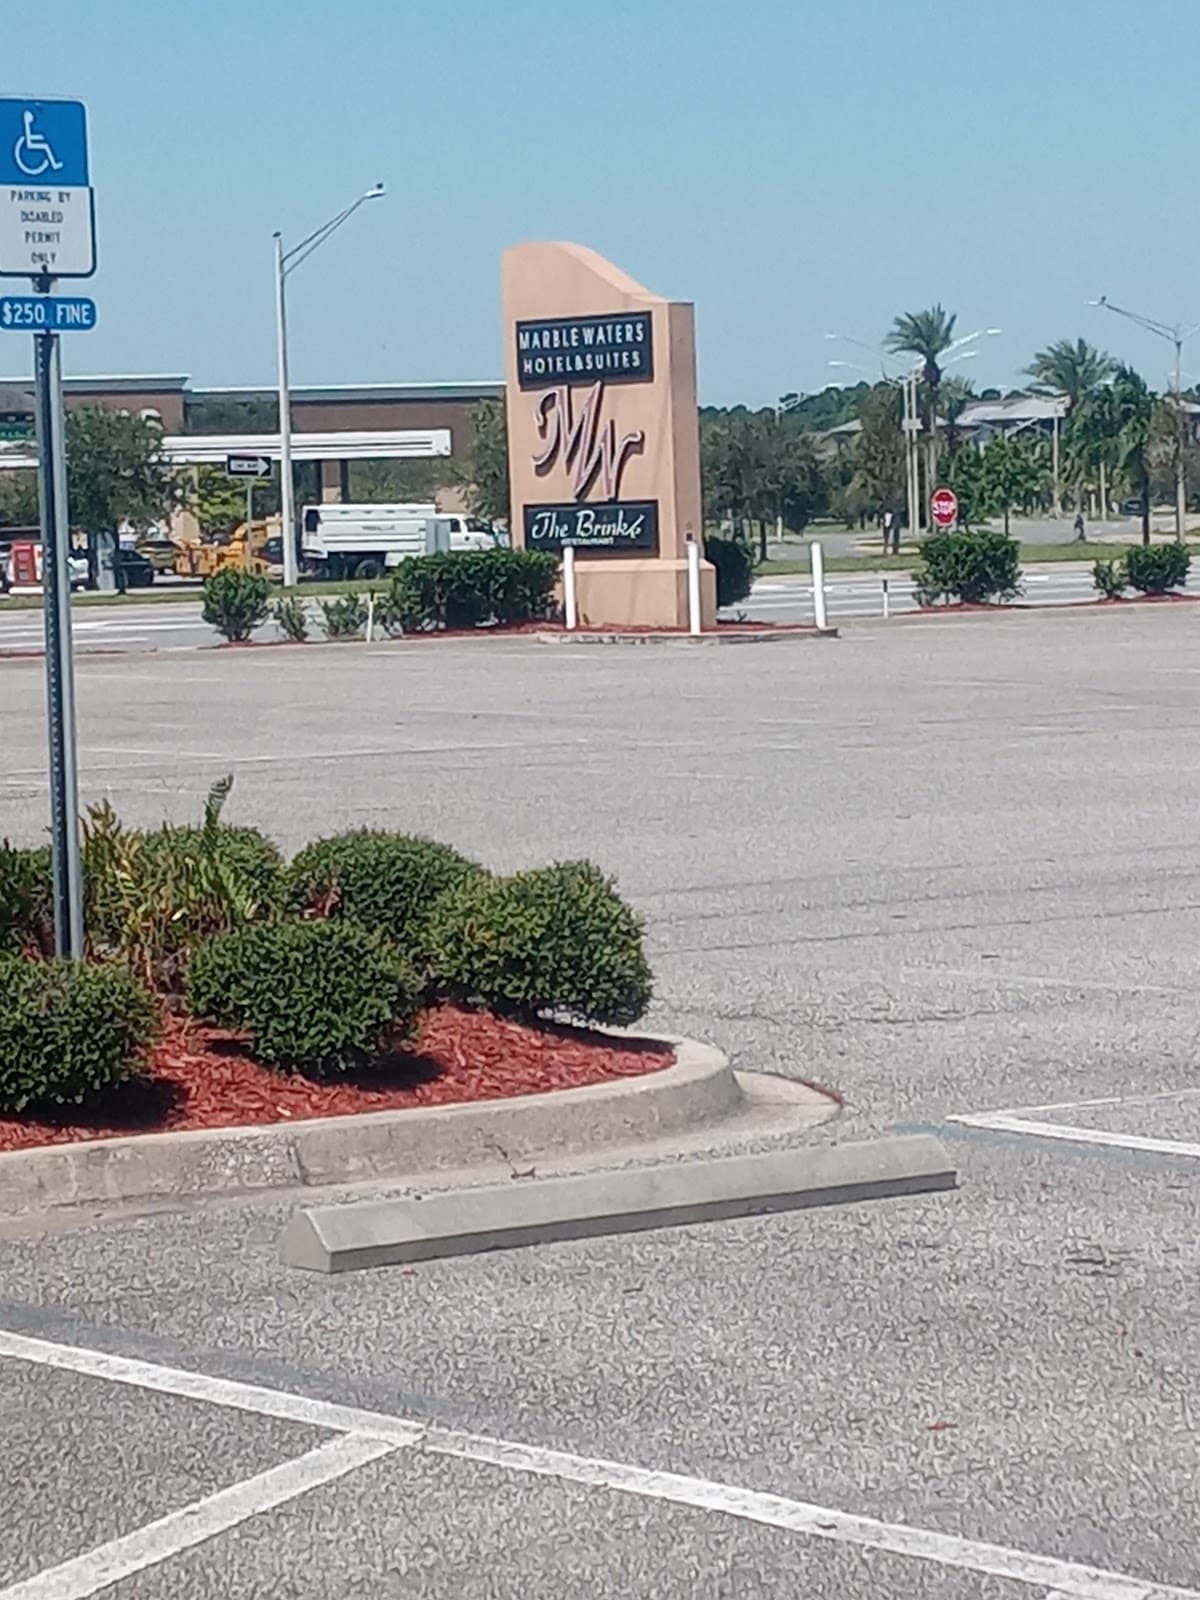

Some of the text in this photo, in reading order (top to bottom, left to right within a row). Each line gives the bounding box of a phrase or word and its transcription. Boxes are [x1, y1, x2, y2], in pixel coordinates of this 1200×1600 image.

[3, 301, 91, 325] $250 FINE
[519, 322, 644, 350] MARBLE WATERS
[531, 511, 569, 539] The
